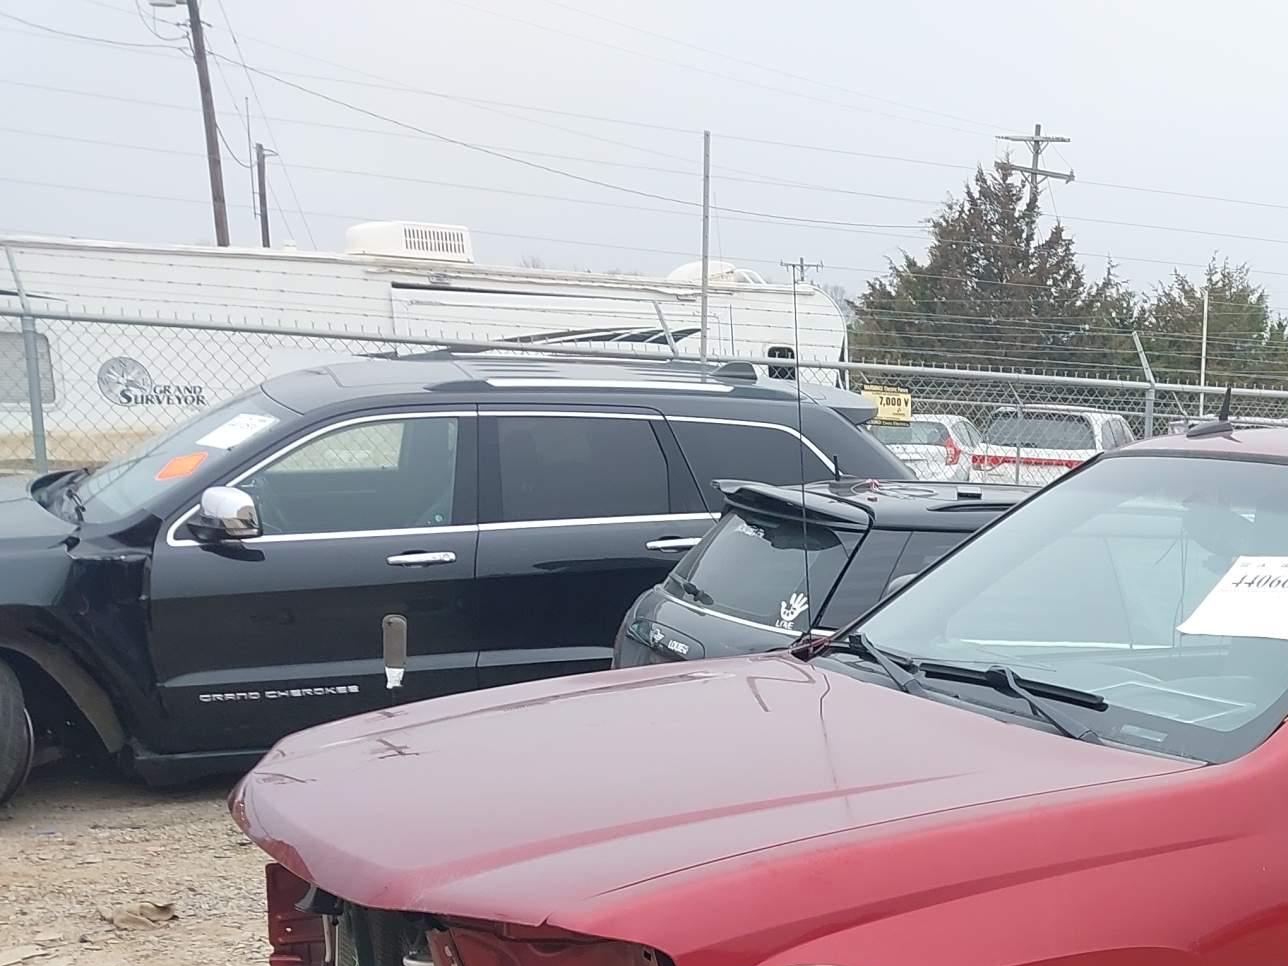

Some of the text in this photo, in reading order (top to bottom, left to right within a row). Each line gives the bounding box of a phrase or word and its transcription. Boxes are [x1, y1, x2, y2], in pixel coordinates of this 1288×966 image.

[119, 388, 206, 405] SURVEYOR
[153, 384, 203, 395] GRAND
[879, 396, 901, 407] 7,000
[199, 685, 361, 703] GRAND CHEROKEE
